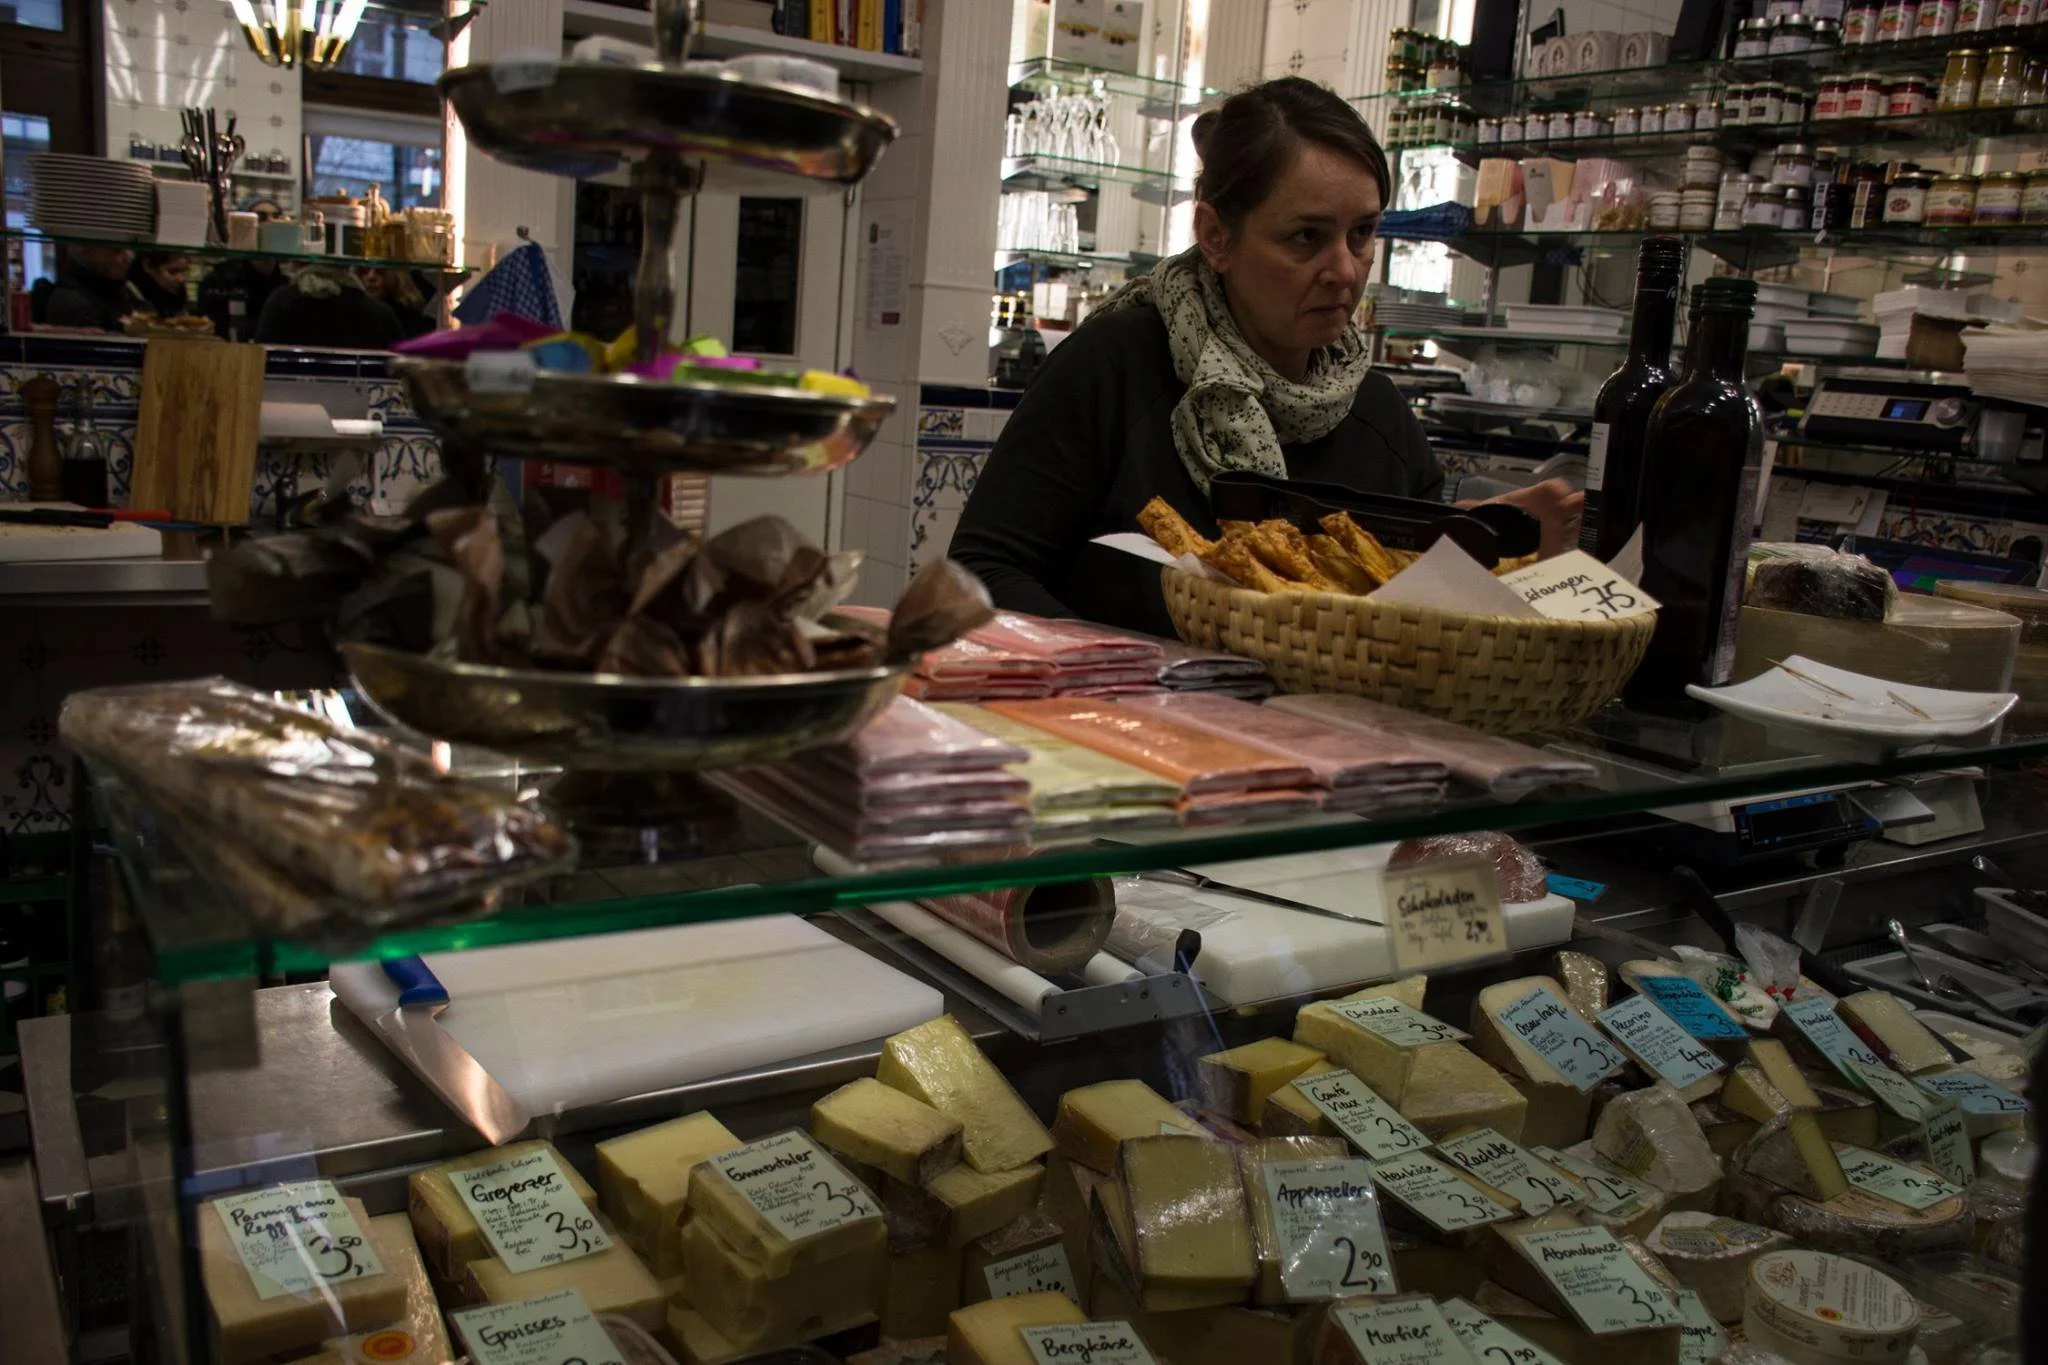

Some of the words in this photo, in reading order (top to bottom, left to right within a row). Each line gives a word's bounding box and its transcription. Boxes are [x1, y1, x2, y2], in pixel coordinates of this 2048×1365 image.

[1611, 1010, 1651, 1032] Pecorino
[725, 1151, 813, 1181] Emmentaler
[1377, 1164, 1438, 1182] Heukäse
[472, 1172, 556, 1203] Greyerzer
[1277, 1181, 1368, 1208] Appenzeller
[1334, 1236, 1382, 1292] 2,90
[1541, 1243, 1623, 1261] Abondance
[478, 1316, 566, 1350] Epoisses
[1365, 1325, 1432, 1346] Morbier
[1041, 1335, 1134, 1363] Bergkäse
